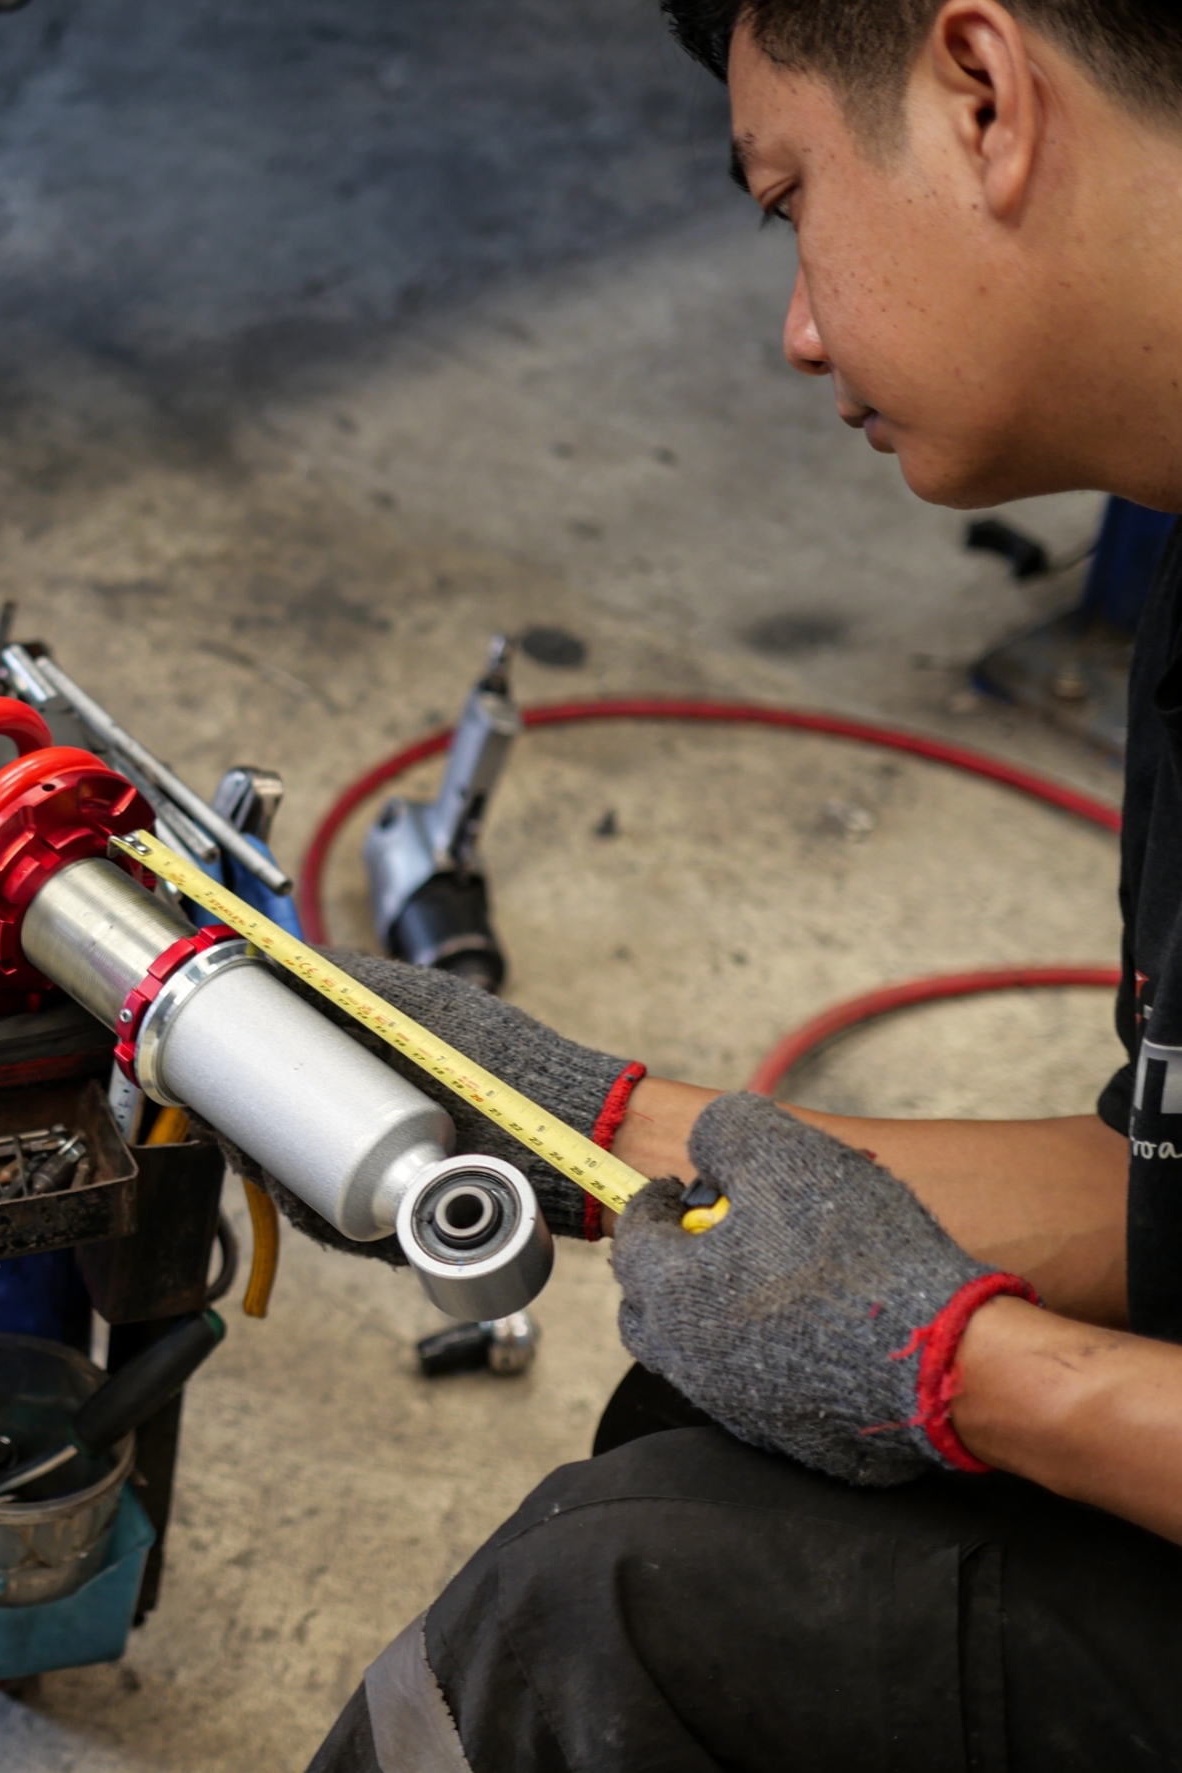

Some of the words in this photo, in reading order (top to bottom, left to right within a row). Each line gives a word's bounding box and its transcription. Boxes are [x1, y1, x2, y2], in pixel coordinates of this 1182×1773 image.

[470, 1093, 484, 1103] 20
[488, 1107, 502, 1117] 21
[508, 1122, 524, 1133] 22
[529, 1136, 544, 1147] 23
[549, 1151, 564, 1162] 24
[569, 1165, 585, 1177] 25
[590, 1180, 606, 1192] 26
[611, 1195, 627, 1206] 27
[536, 1124, 546, 1133] 9
[583, 1157, 598, 1169] 10
